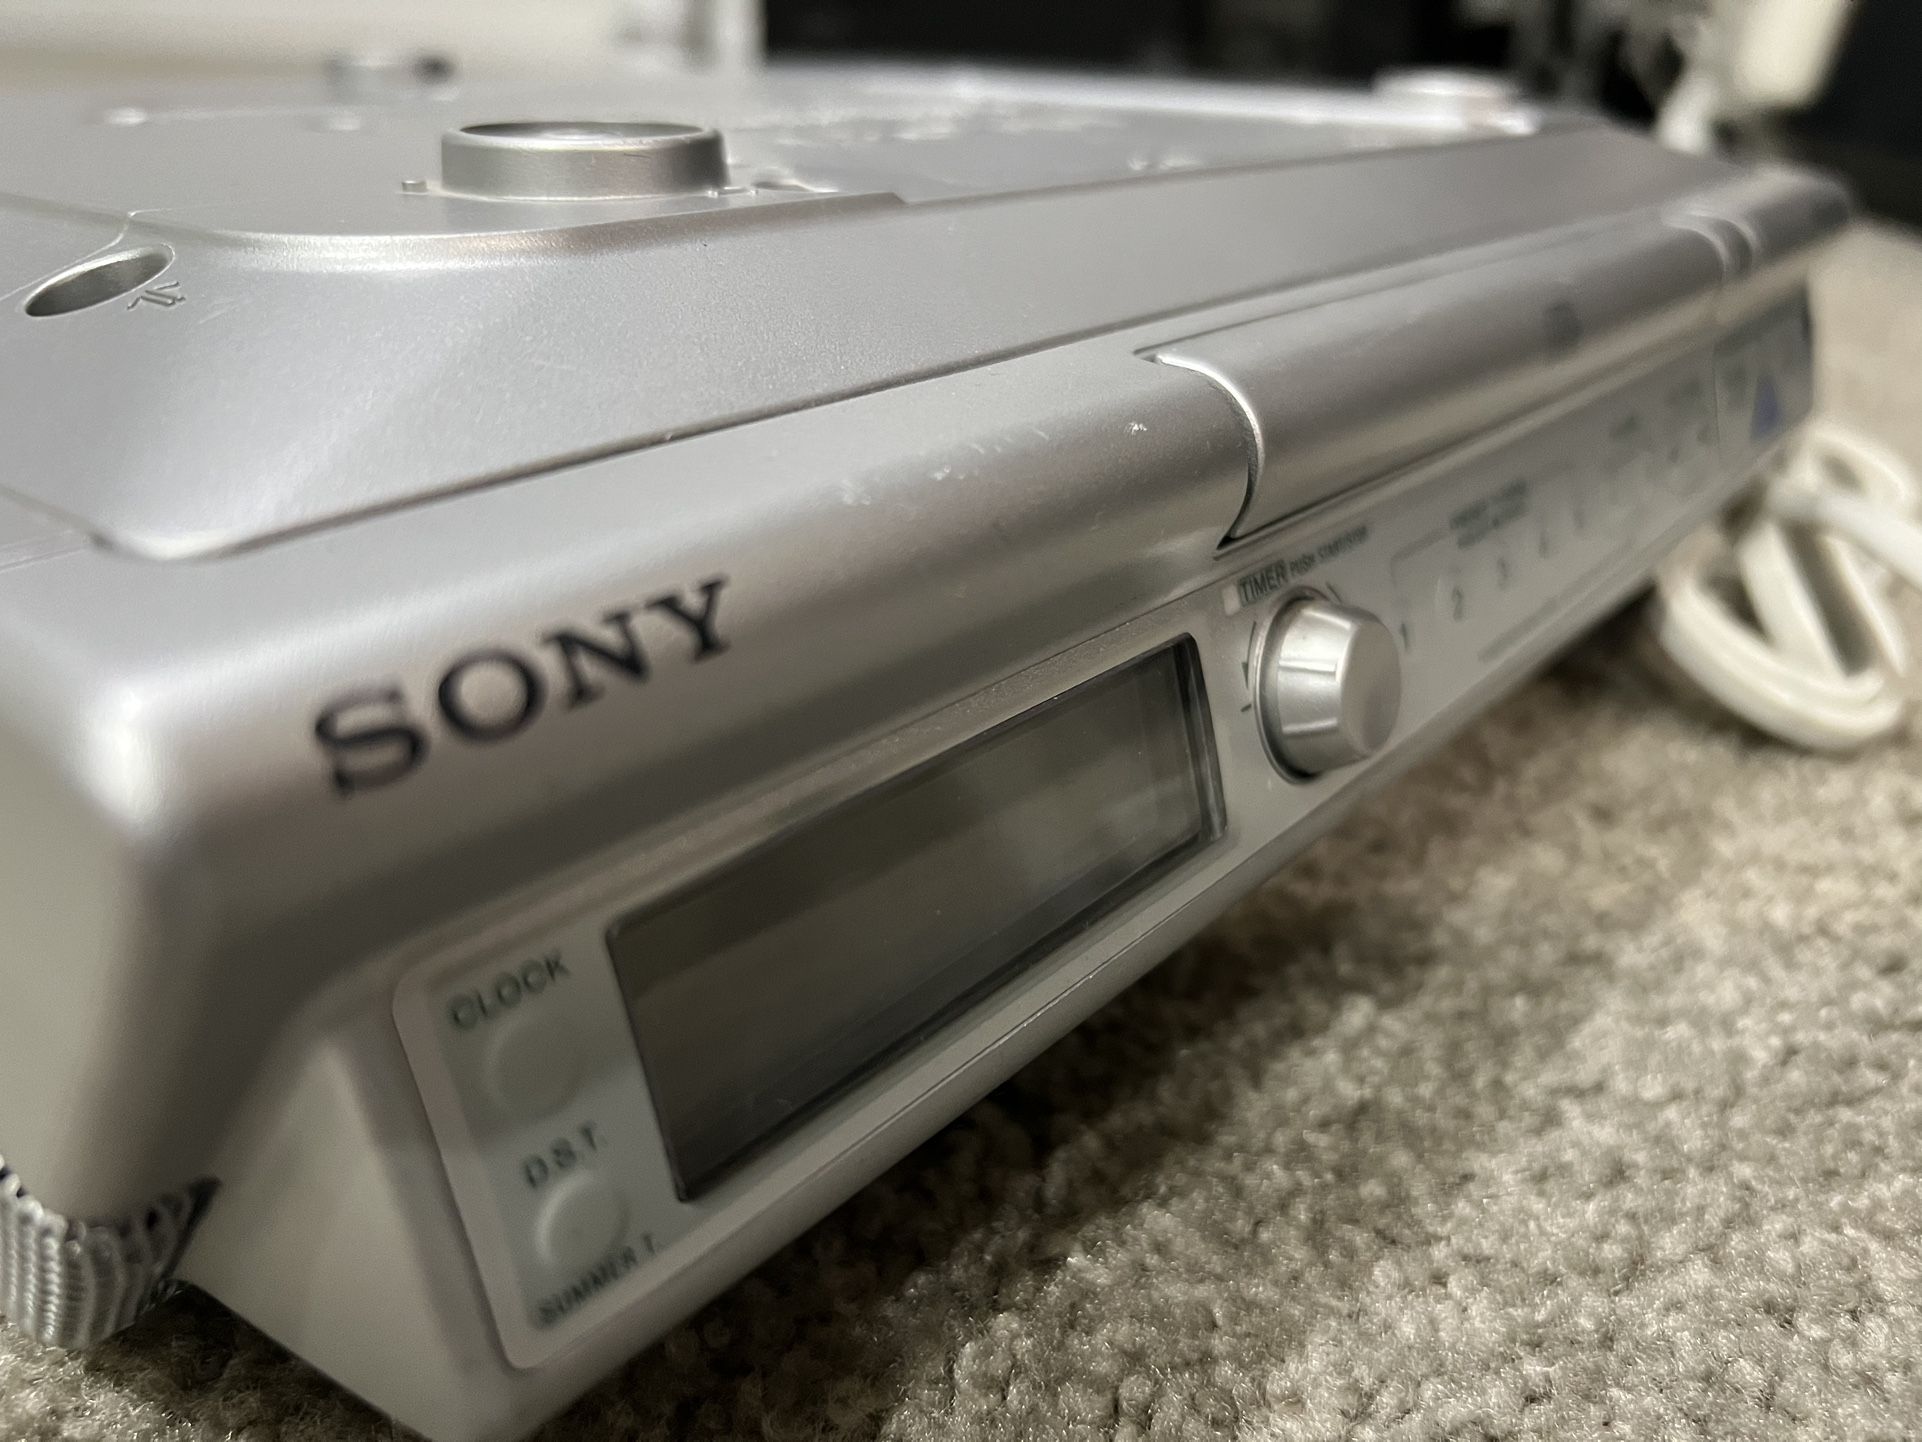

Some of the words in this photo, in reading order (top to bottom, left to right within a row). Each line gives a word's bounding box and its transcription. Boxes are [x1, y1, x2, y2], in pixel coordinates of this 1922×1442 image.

[1239, 560, 1288, 604] TIMER
[312, 574, 730, 796] SONY
[449, 950, 569, 1031] CLOCK
[538, 1246, 638, 1324] SUMMER
